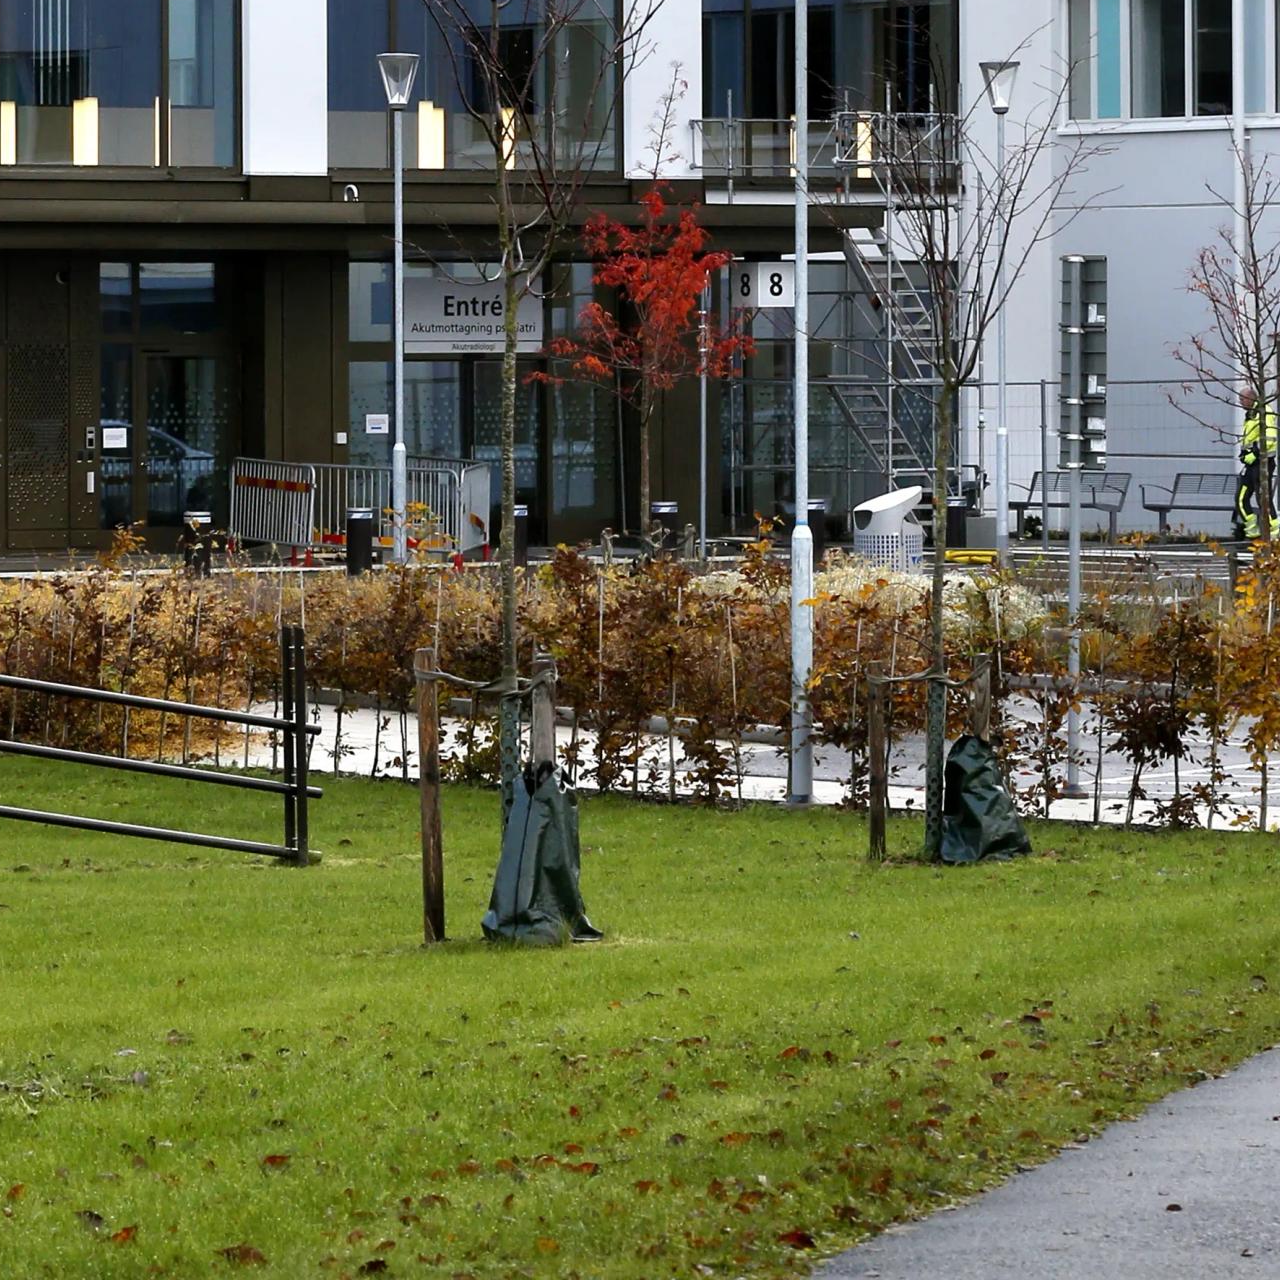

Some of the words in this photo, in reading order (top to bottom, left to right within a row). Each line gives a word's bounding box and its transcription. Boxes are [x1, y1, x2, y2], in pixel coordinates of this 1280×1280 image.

[740, 272, 751, 297] 8
[769, 272, 783, 297] 8
[443, 294, 503, 317] Entré
[411, 322, 493, 336] Akutmottagning
[495, 322, 537, 336] psiatri
[451, 342, 496, 352] Akutradiologi
